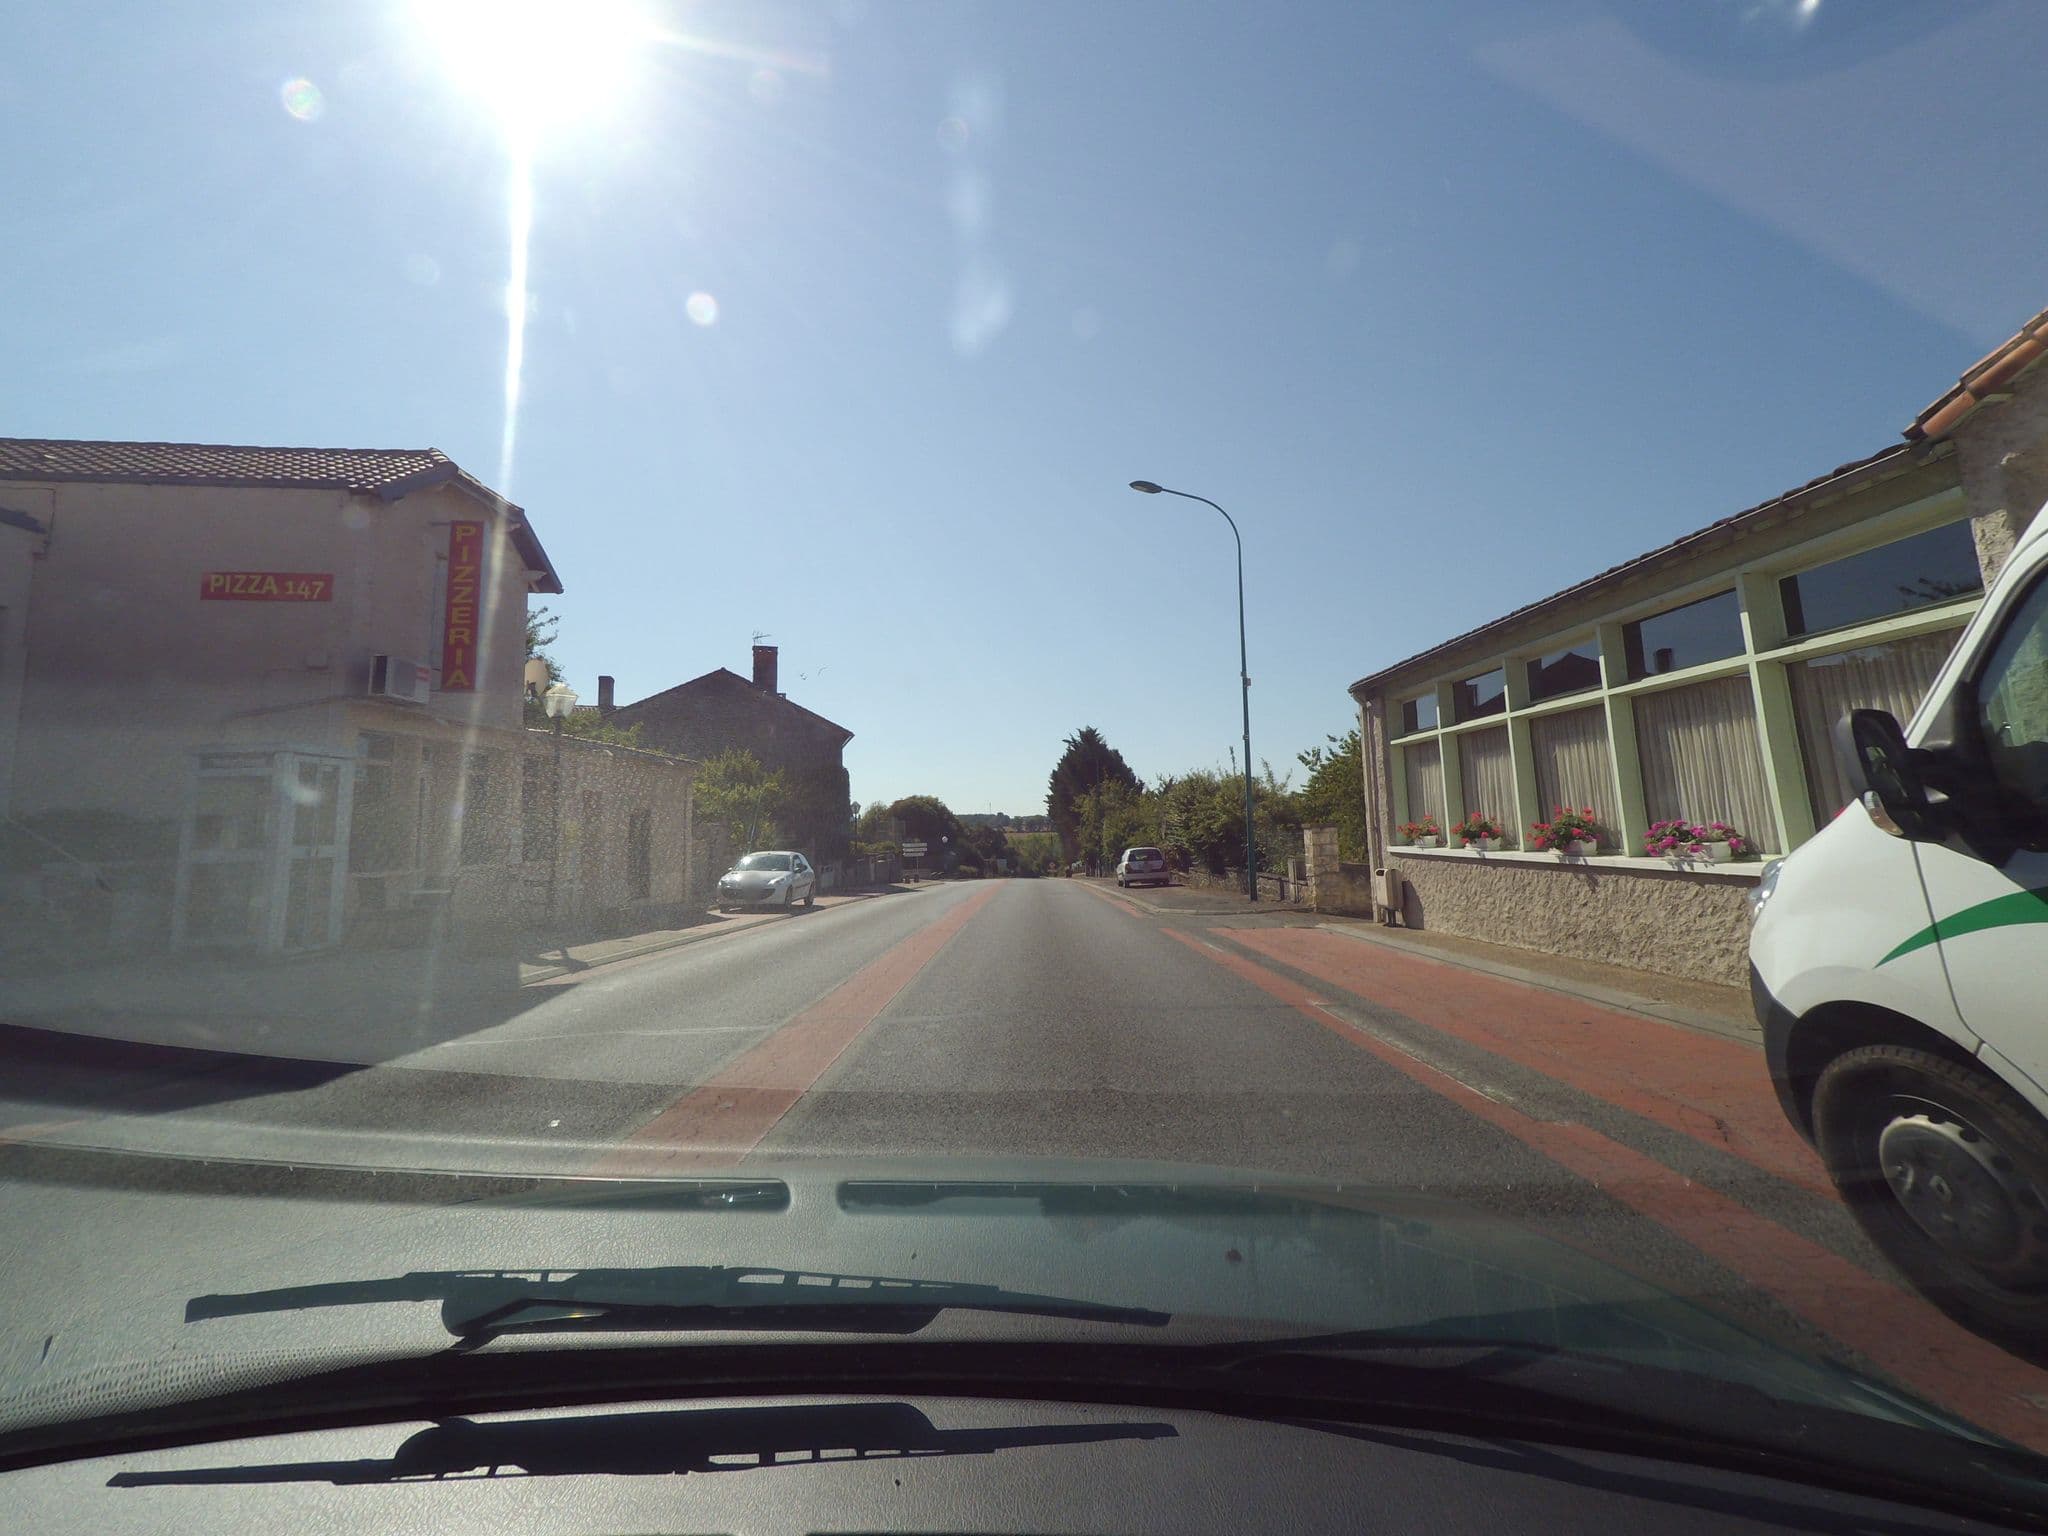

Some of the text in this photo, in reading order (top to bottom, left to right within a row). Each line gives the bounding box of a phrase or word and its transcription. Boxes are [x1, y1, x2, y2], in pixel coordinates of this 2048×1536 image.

[209, 574, 325, 600] PIZZA 147
[446, 525, 476, 686] PIZZERIA
